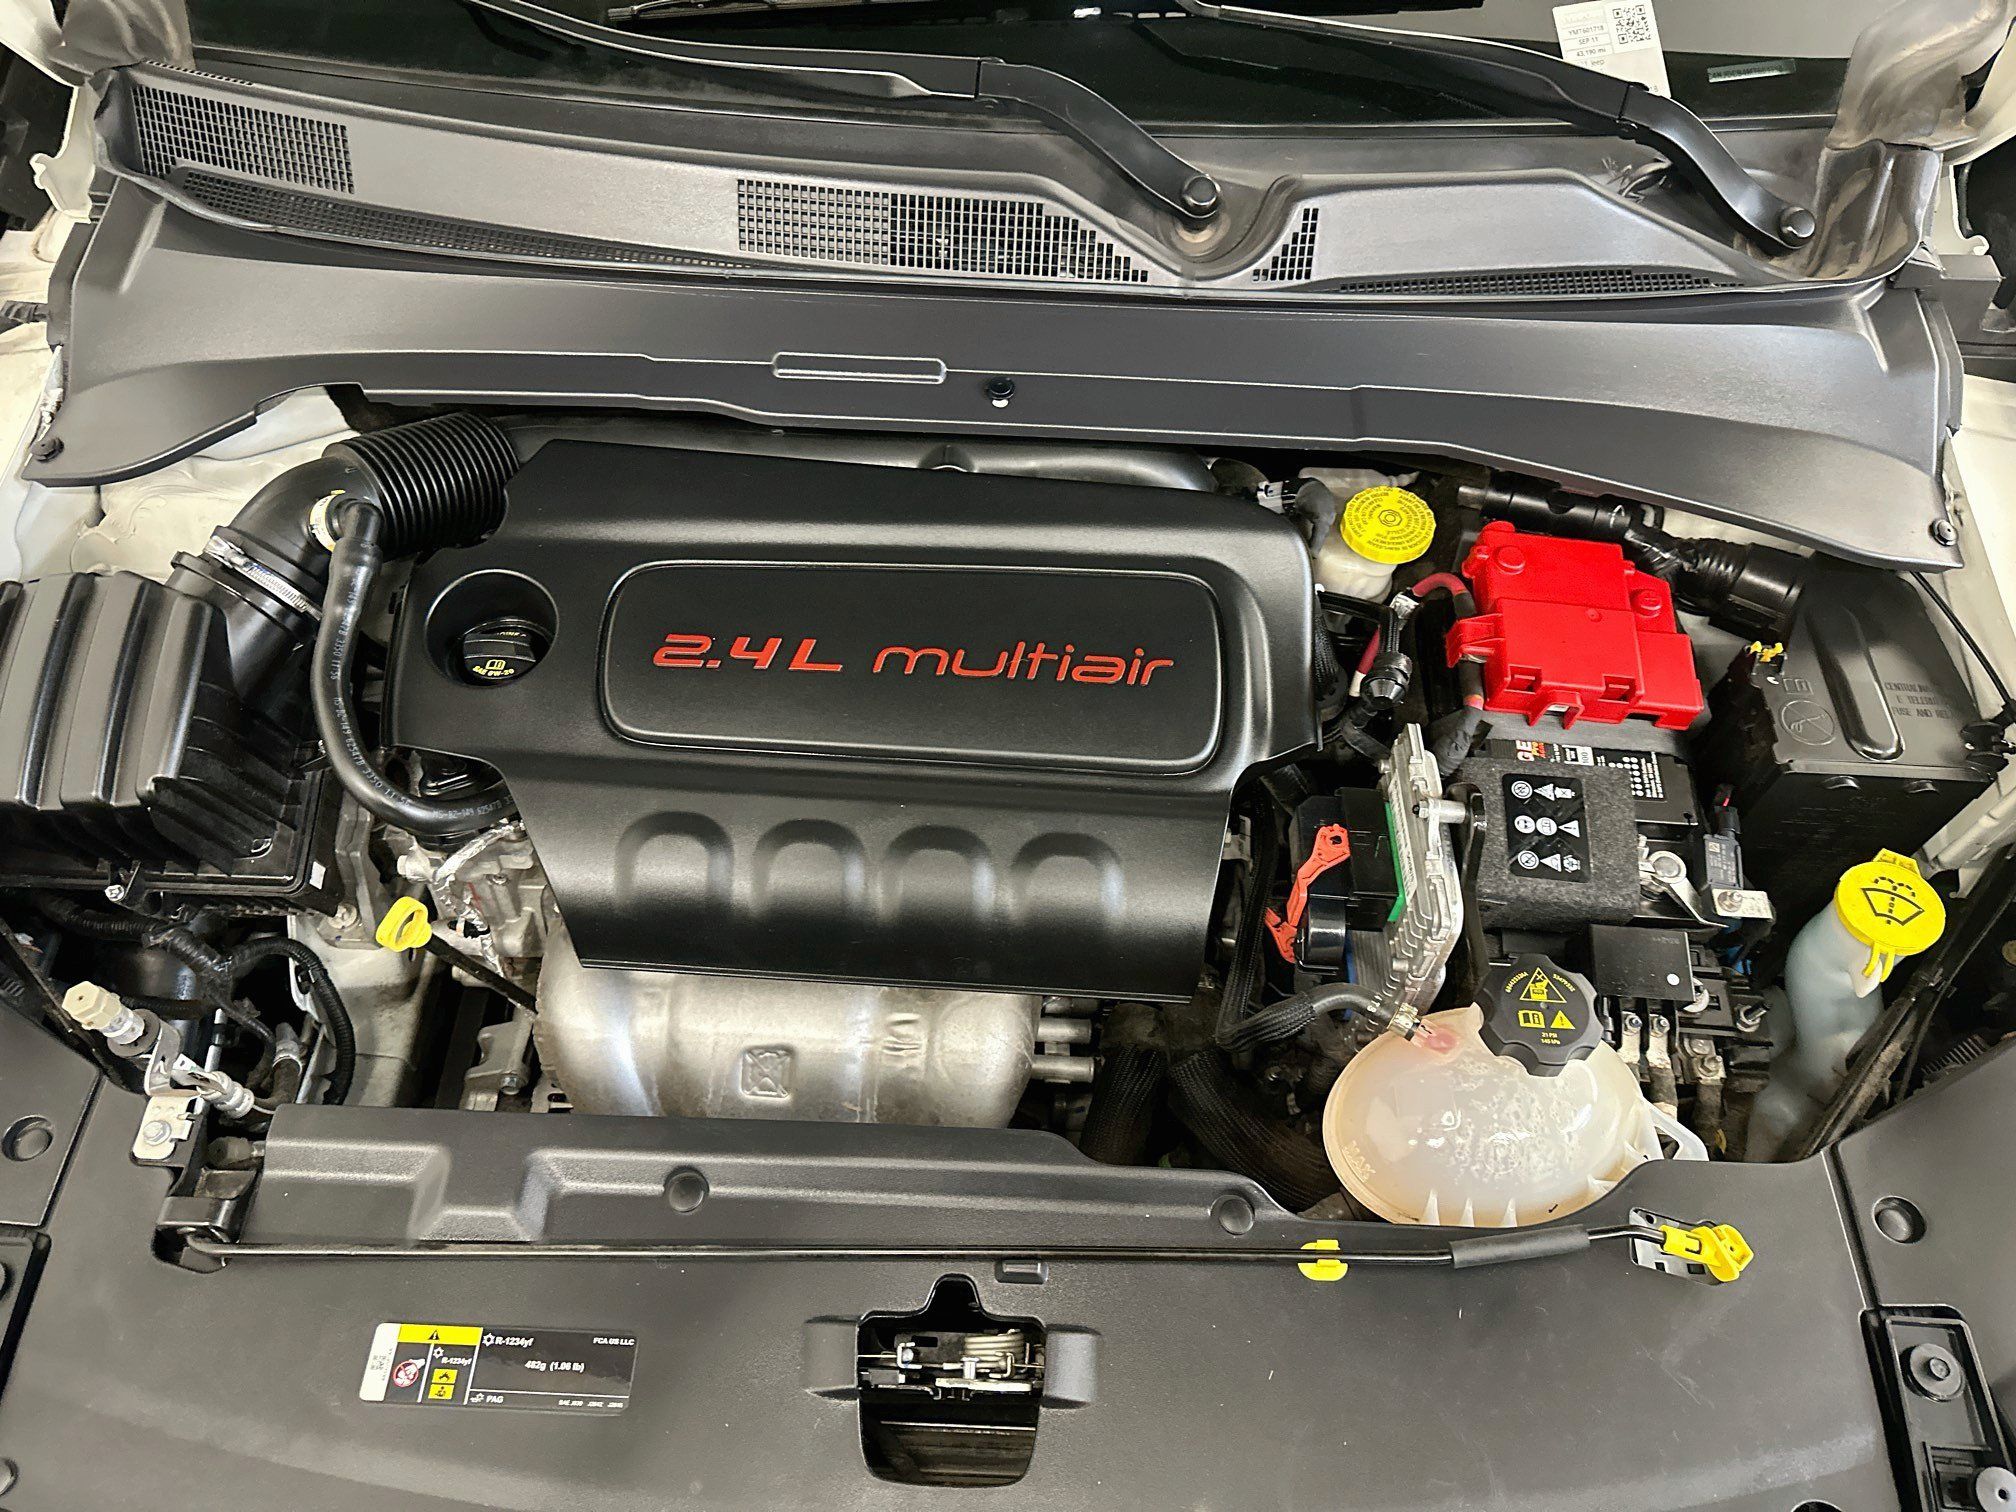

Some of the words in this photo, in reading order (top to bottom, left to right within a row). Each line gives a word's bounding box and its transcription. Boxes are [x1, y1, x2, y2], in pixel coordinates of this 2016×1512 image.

[872, 642, 1174, 686] multiair
[472, 665, 488, 676] SAE
[487, 668, 515, 676] 0W-20
[1916, 708, 1932, 718] AND
[494, 1336, 534, 1348] R-1234yf
[593, 1337, 608, 1345] FCA
[619, 1338, 635, 1346] LLC
[486, 1395, 504, 1404] PAG
